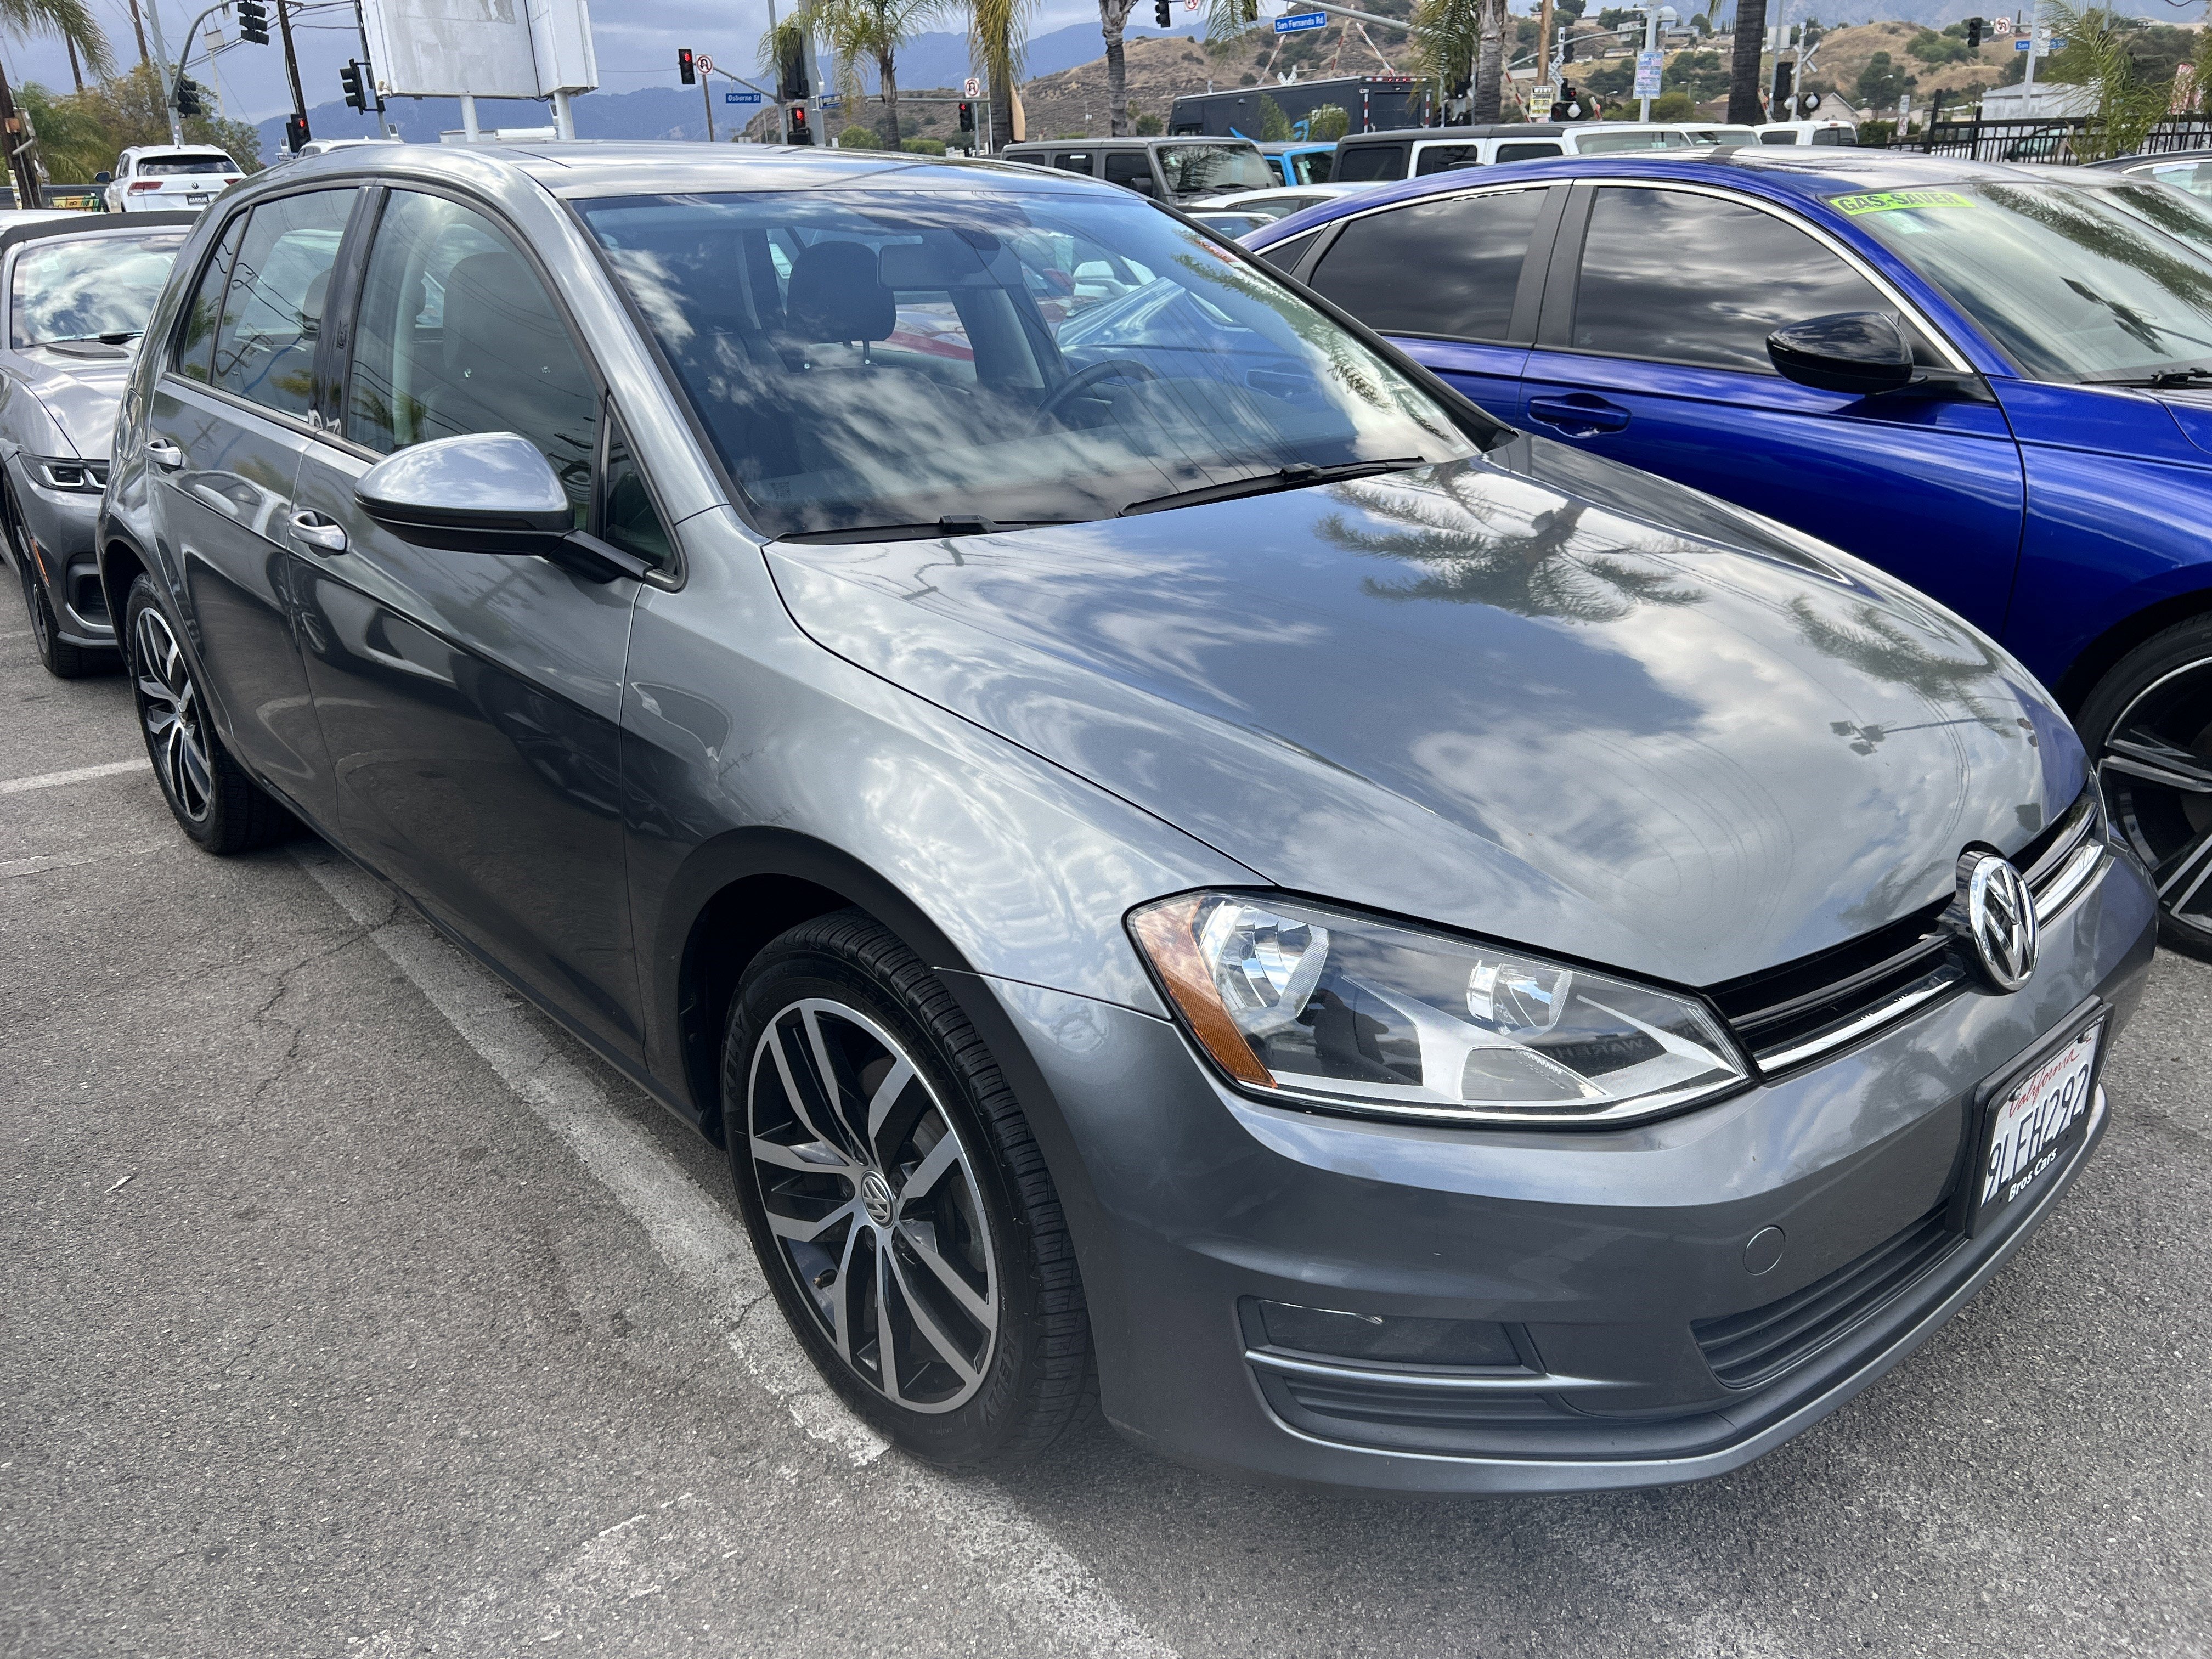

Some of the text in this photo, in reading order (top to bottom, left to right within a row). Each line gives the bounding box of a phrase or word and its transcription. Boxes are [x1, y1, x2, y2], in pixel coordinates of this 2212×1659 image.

[1276, 16, 1324, 30] San Fernando Rd
[1838, 194, 1960, 211] GAS-SAVER
[725, 1011, 748, 1098] KELLY
[2009, 1048, 2080, 1118] California
[1981, 1063, 2089, 1207] 9LFH292
[2008, 1147, 2057, 1203] Bros Cars
